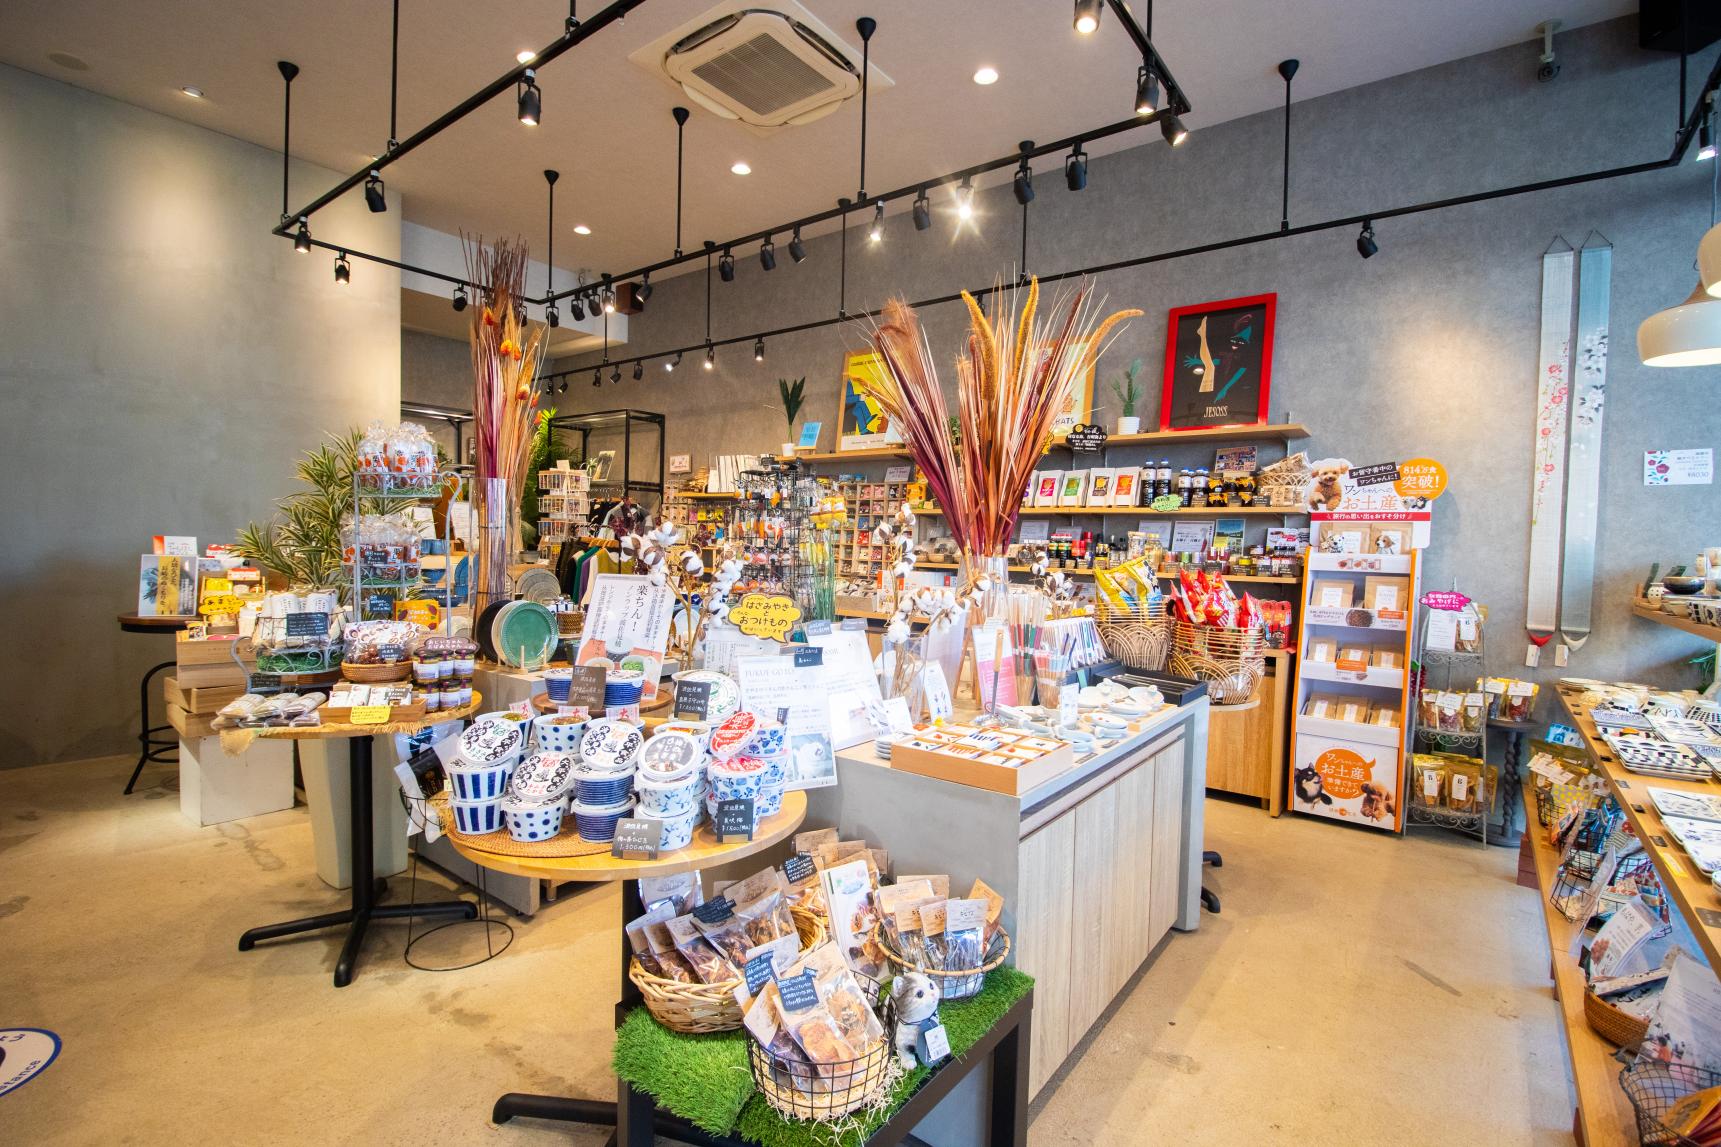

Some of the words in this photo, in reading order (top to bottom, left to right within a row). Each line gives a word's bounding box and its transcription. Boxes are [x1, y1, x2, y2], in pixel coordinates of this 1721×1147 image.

[1342, 495, 1398, 511] お土産
[746, 601, 789, 611] はさみやき
[739, 616, 788, 627] おつけもの
[1321, 763, 1365, 781] お土産
